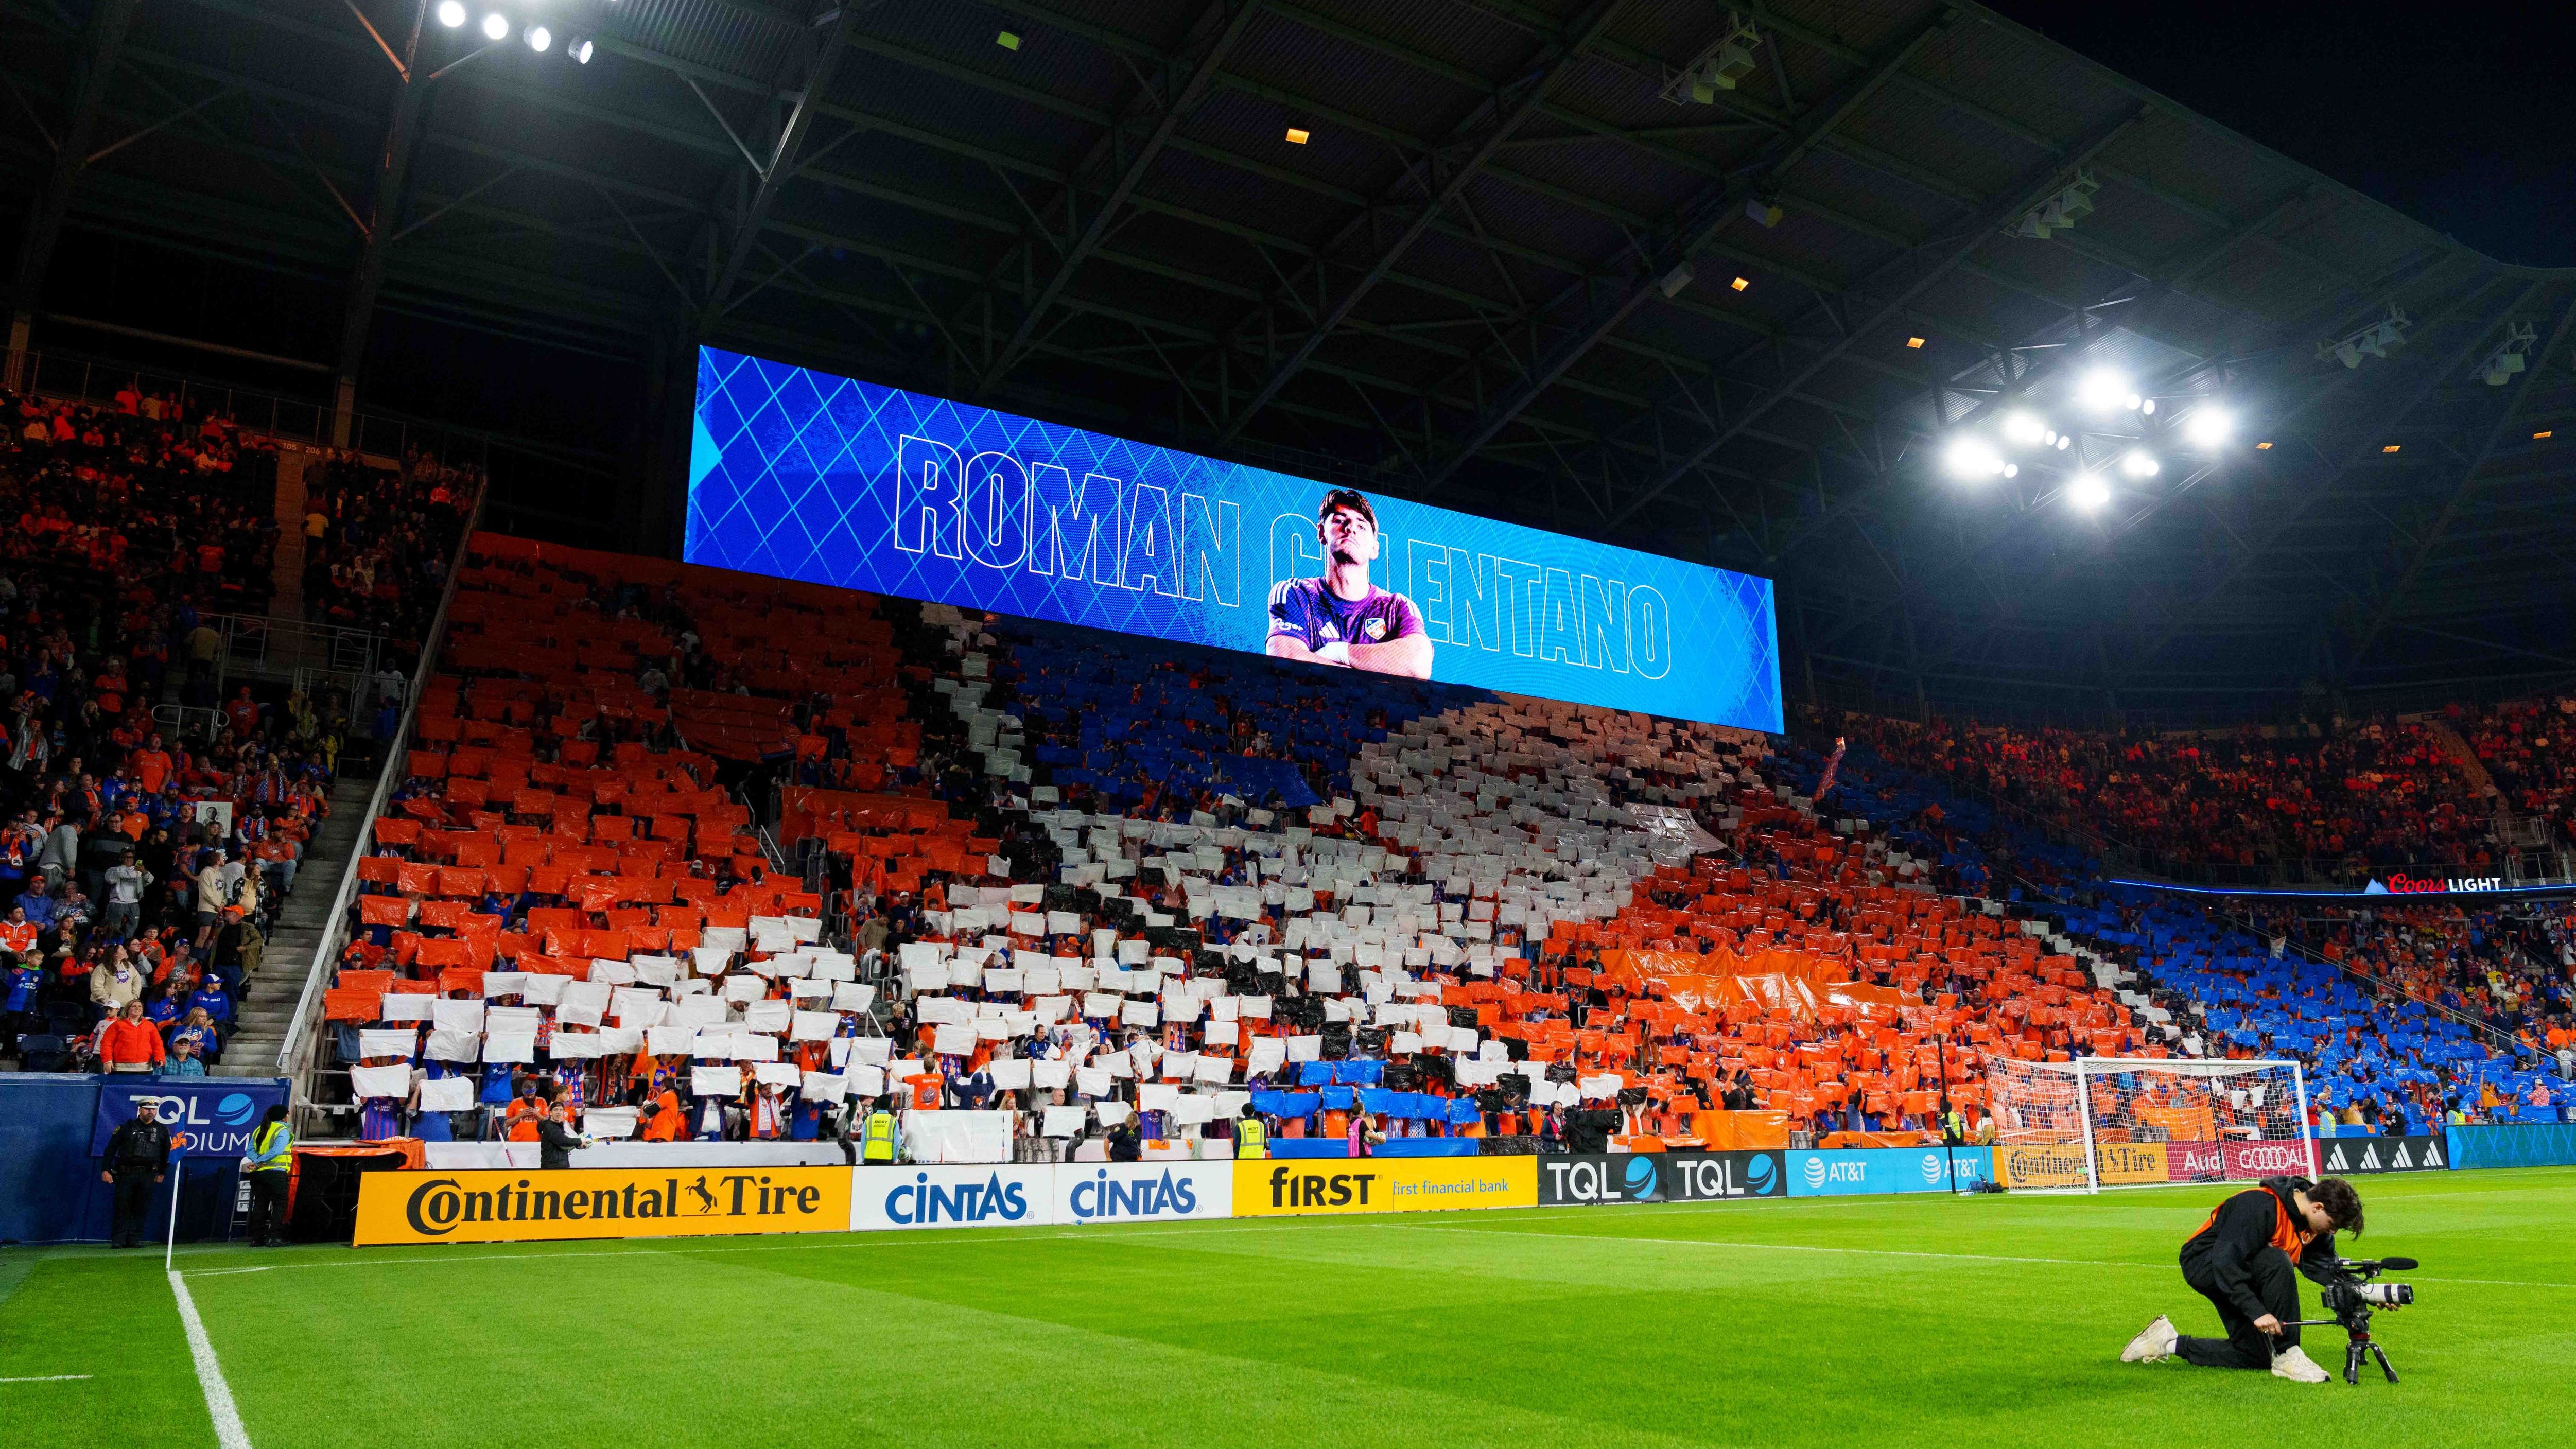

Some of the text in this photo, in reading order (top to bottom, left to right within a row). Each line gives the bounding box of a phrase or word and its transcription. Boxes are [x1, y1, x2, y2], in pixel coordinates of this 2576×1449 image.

[282, 442, 320, 455] 105 206
[894, 434, 1240, 607] ROMAN
[1270, 513, 1671, 680] CENTANO
[2387, 873, 2501, 893] Coors LIGHT
[184, 1132, 250, 1152] DIUM
[1676, 1159, 1745, 1197] TQL
[1828, 1161, 1867, 1182] AT&T
[1944, 1159, 1978, 1178] AT&T
[2010, 1147, 2155, 1183] Continenl Tire
[1393, 1178, 1509, 1196] first financial bank
[1547, 1160, 1621, 1200] TQL
[406, 1175, 820, 1235] Continental Tire
